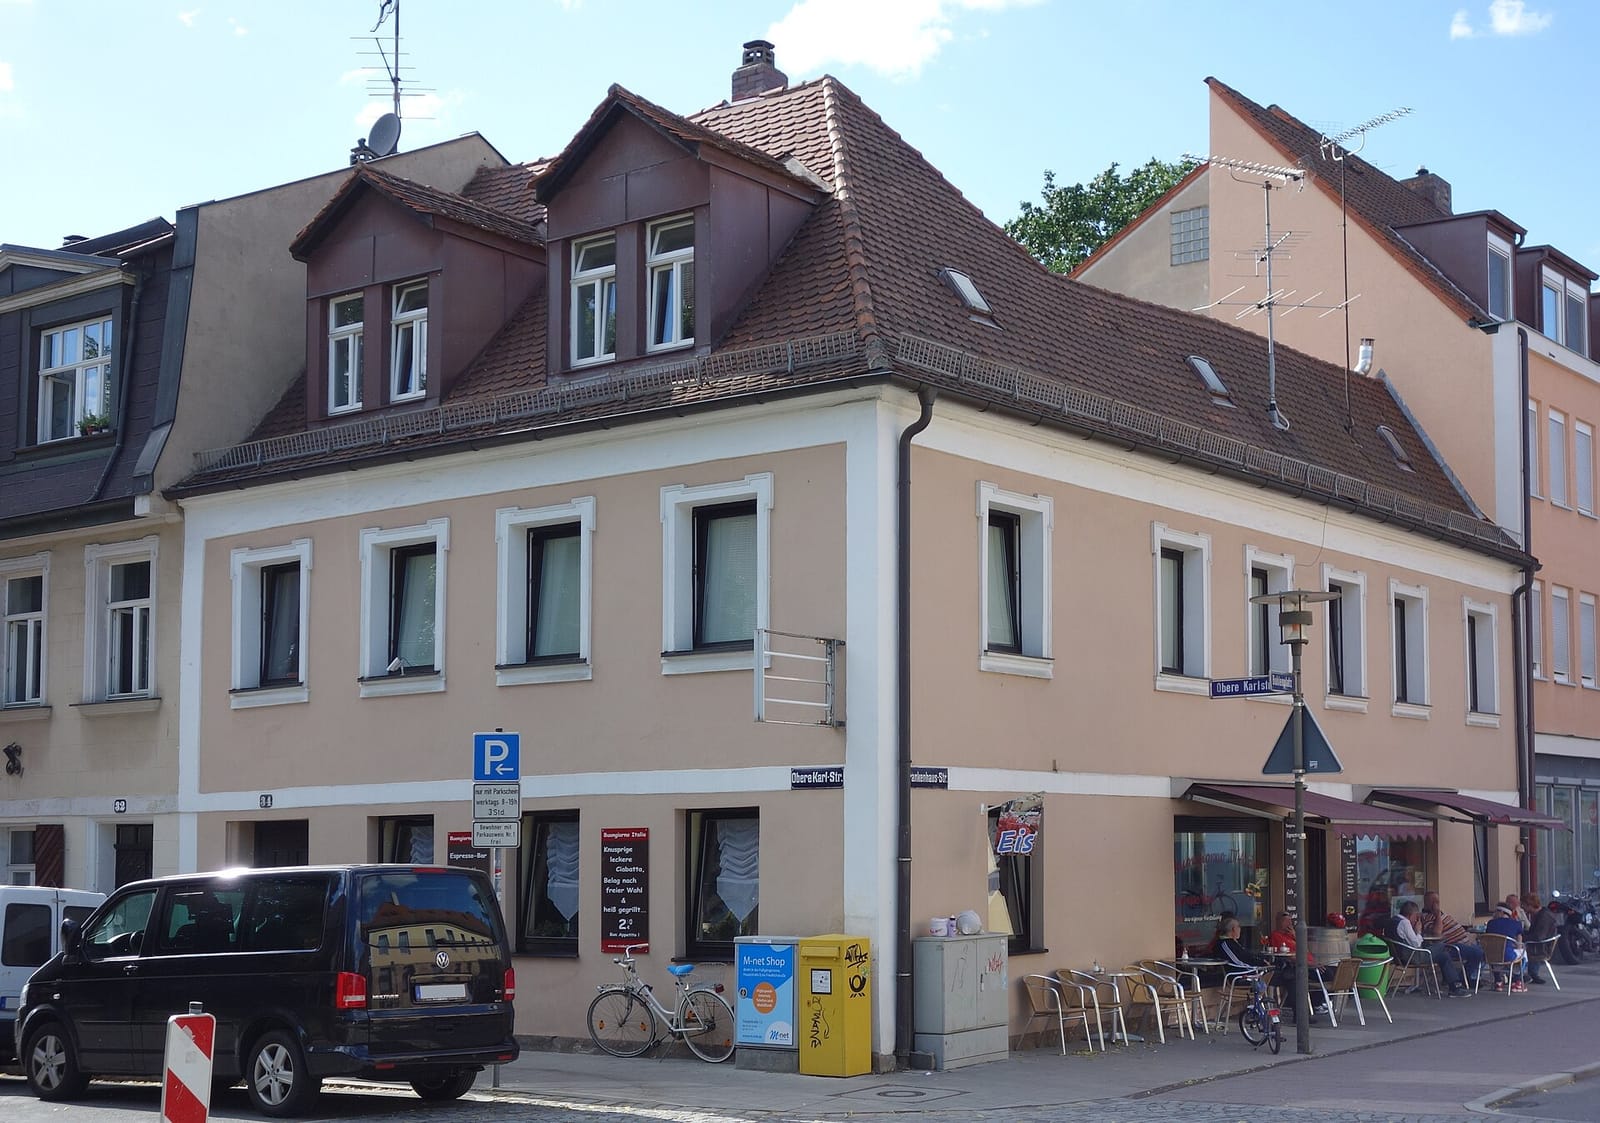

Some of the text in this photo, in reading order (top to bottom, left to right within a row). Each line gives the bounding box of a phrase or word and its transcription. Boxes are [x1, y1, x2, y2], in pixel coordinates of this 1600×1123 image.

[1216, 682, 1240, 692] Obere
[484, 740, 508, 775] P
[792, 772, 812, 783] Obere
[997, 828, 1034, 853] Eis
[743, 956, 785, 968] M-net Shop
